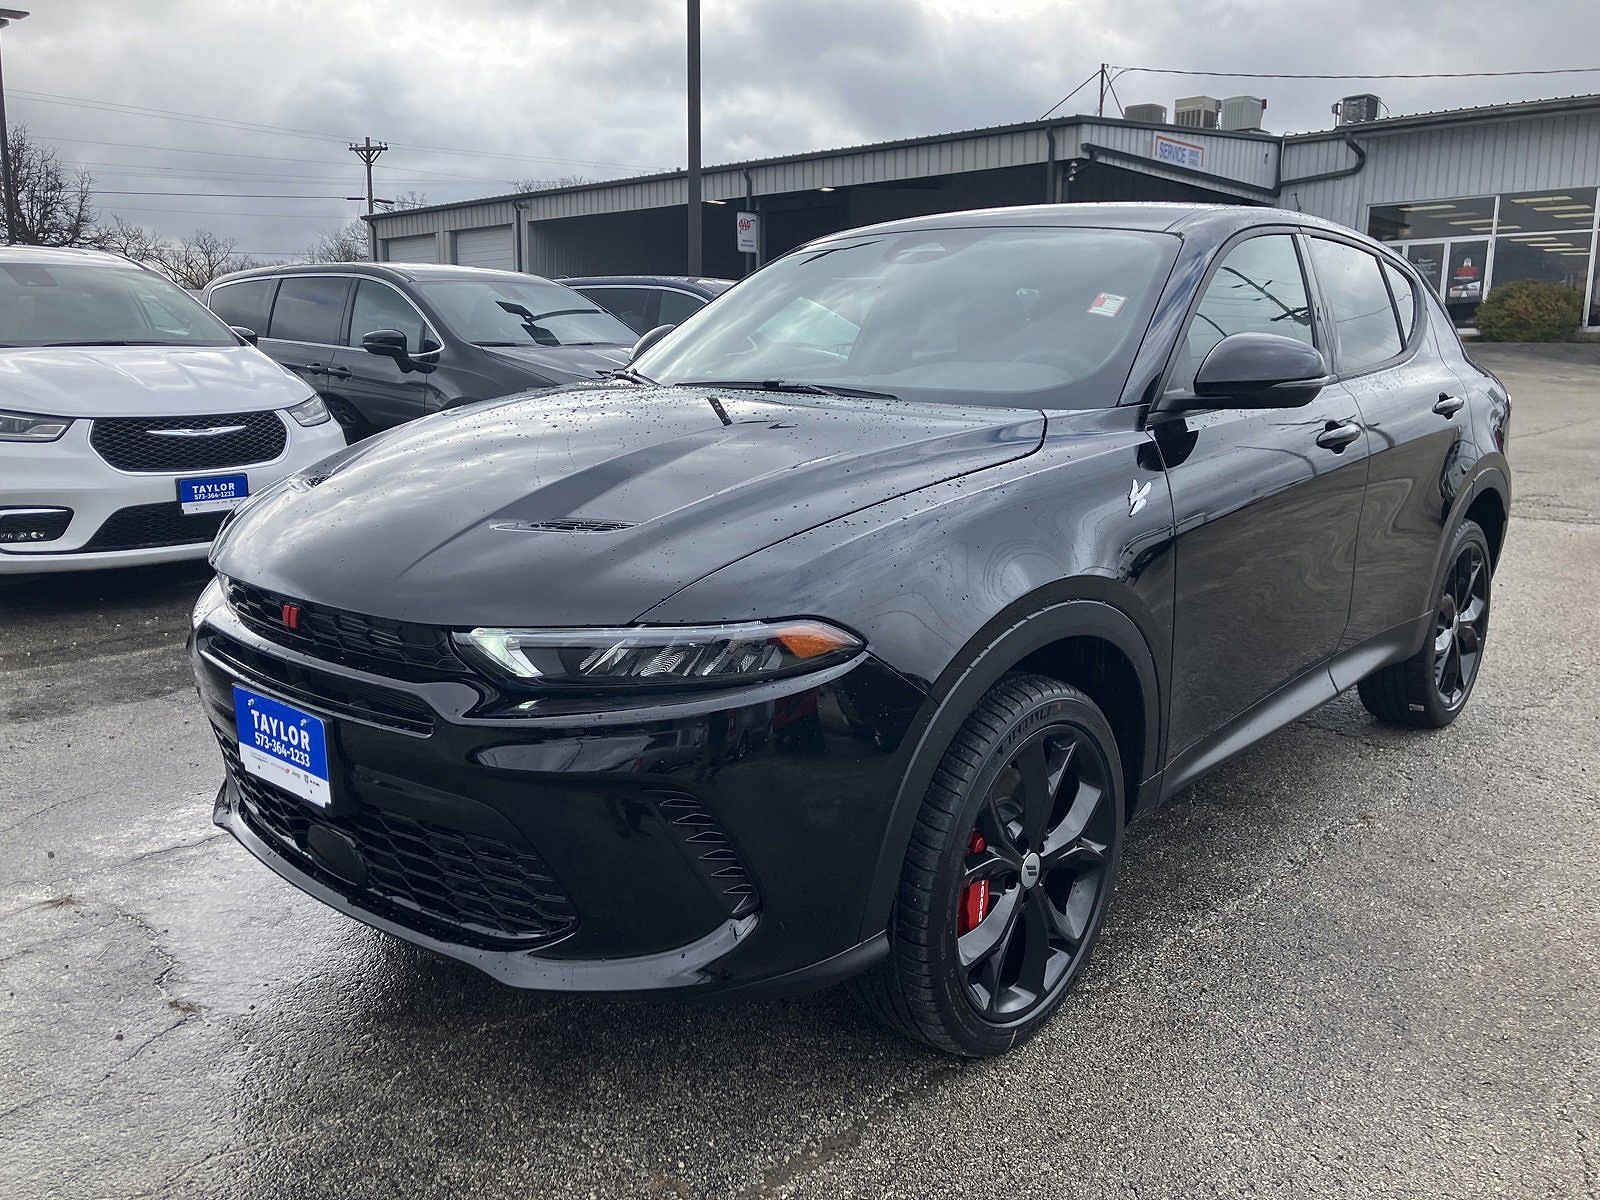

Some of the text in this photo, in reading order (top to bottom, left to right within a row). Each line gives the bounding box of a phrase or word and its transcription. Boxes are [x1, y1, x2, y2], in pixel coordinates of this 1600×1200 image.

[1159, 141, 1186, 164] SERVICE
[192, 482, 235, 494] TAYLOR
[194, 490, 235, 500] 573-364-1233
[250, 708, 311, 752] TAYLOR
[254, 731, 311, 768] 573-364-1233
